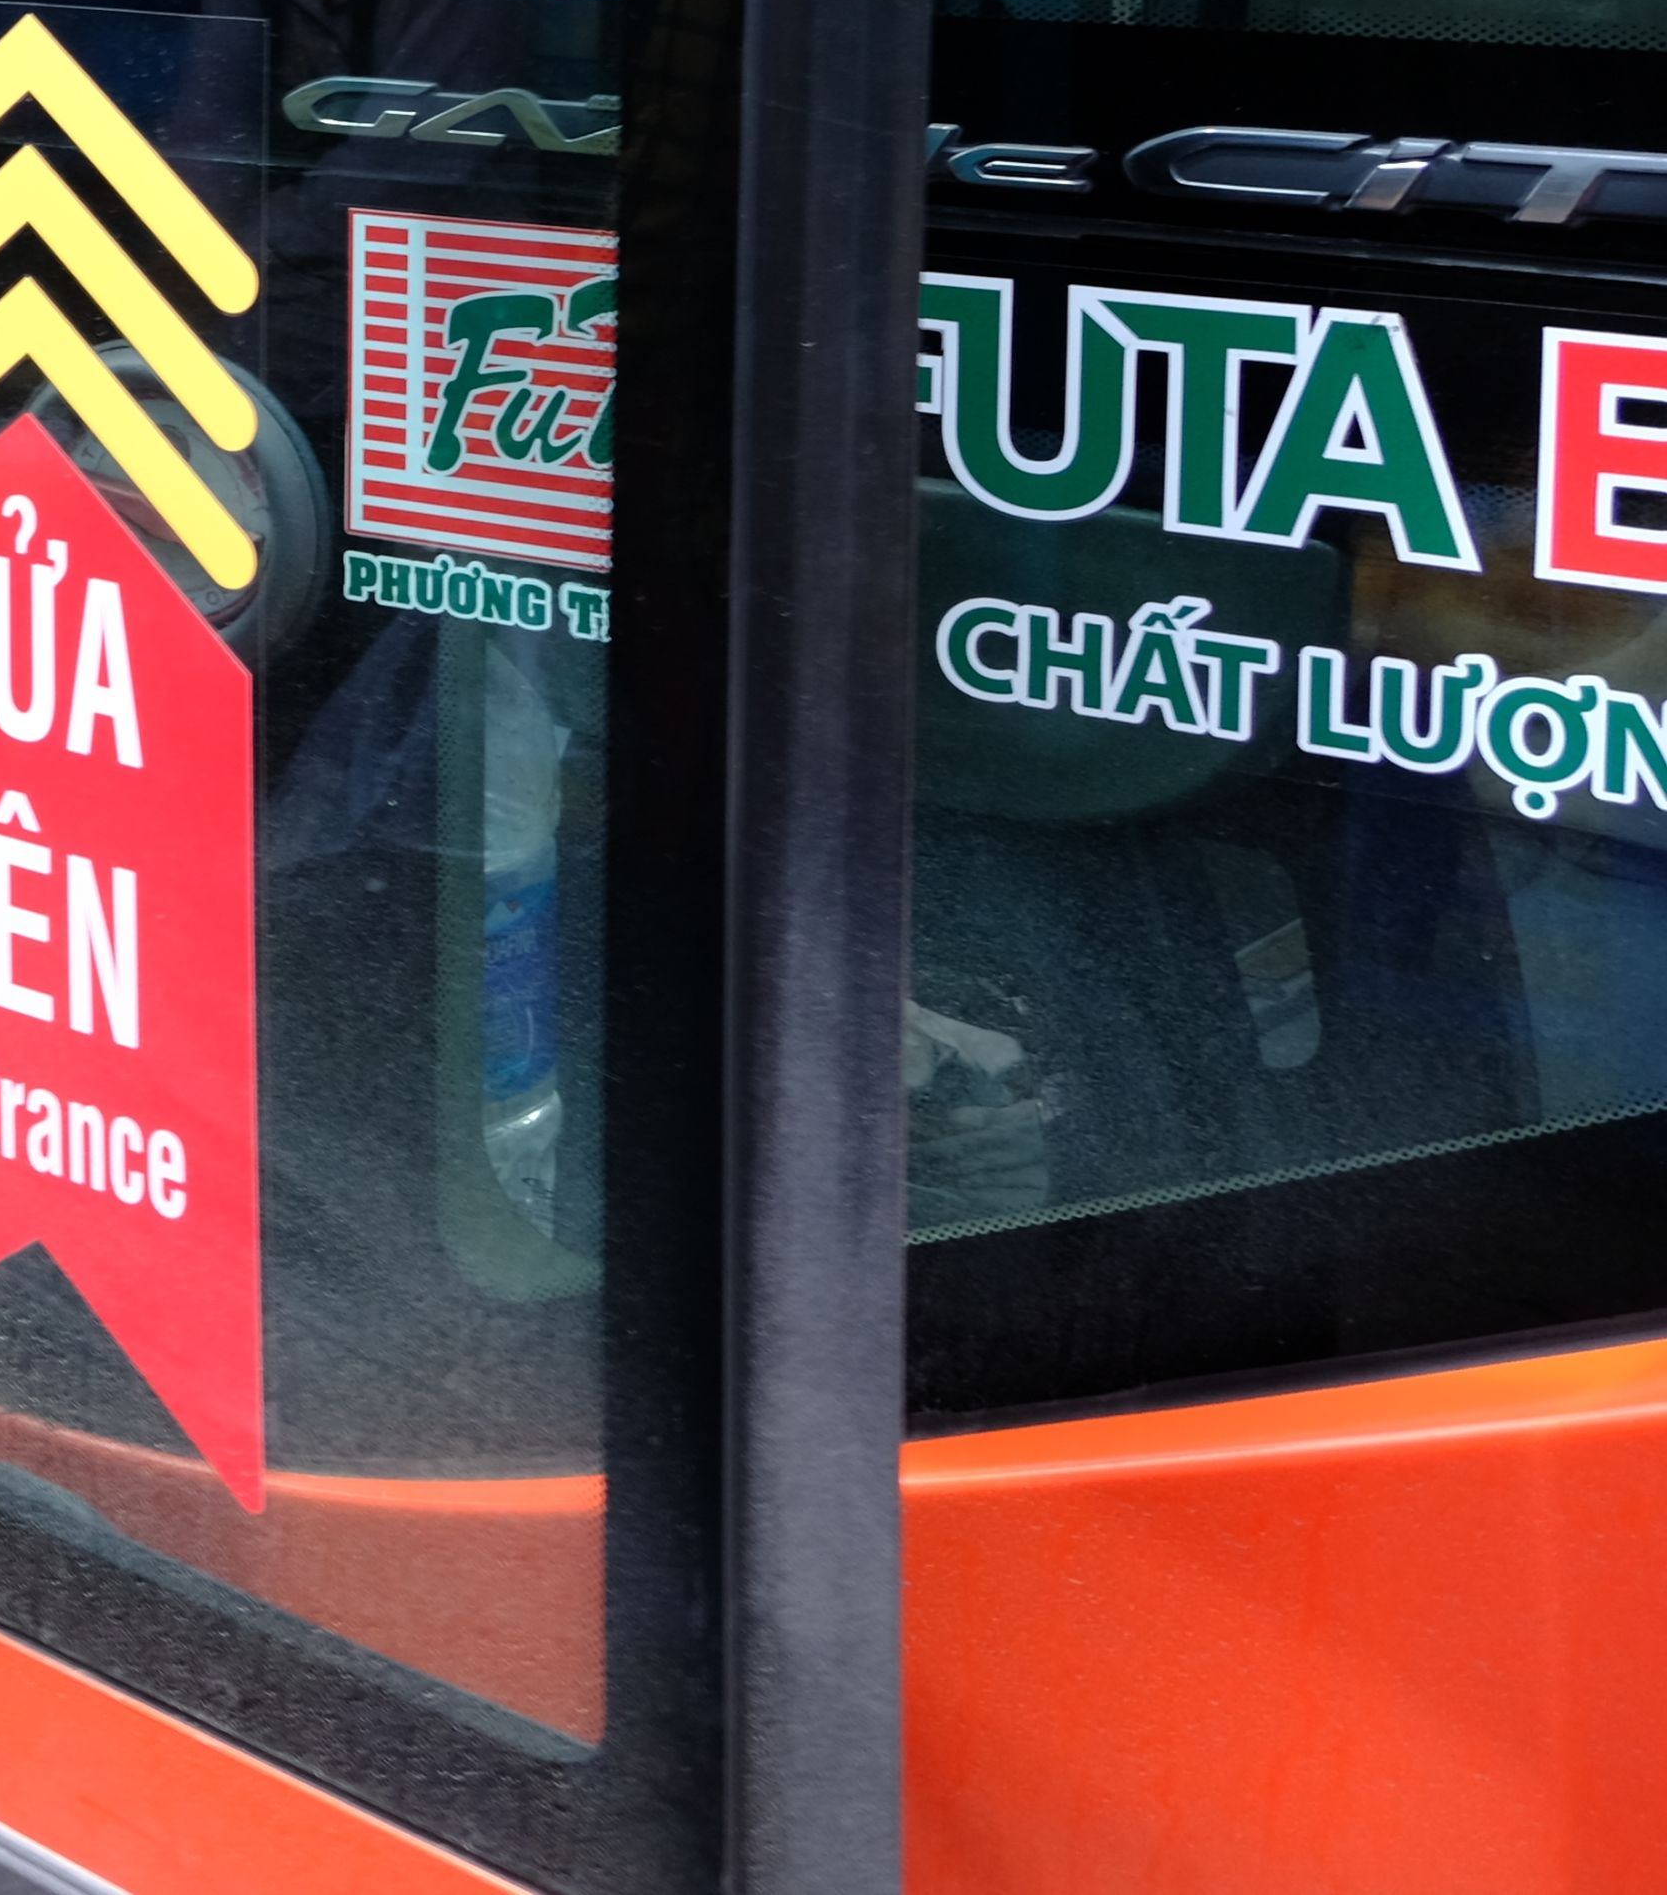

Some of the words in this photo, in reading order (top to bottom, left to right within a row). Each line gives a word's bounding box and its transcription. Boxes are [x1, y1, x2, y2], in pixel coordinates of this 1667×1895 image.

[344, 551, 553, 631] PHƯƠNG
[559, 585, 614, 645] T
[934, 597, 1277, 745] CHẤT
